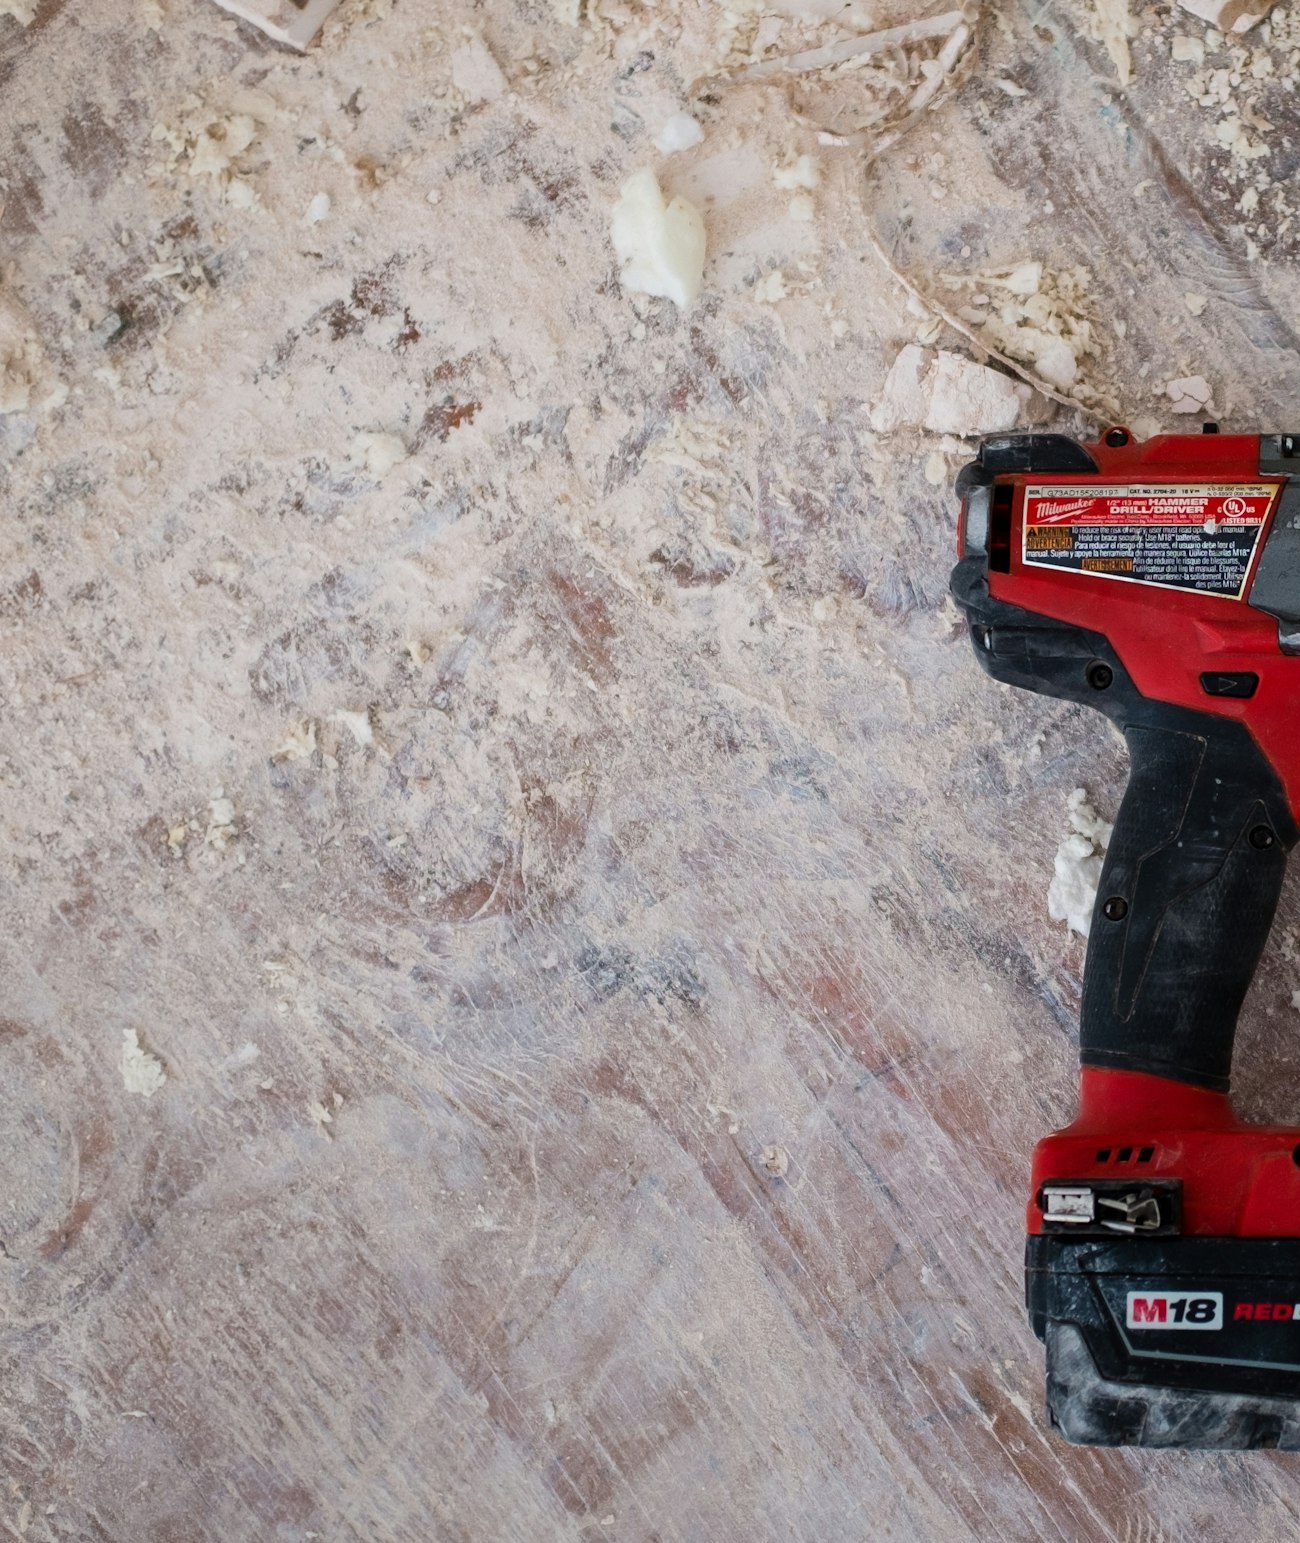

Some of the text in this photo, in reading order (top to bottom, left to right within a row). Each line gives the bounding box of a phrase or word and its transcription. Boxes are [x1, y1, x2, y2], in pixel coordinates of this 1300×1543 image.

[1035, 499, 1094, 518] Milwaukee
[1110, 506, 1204, 514] DRILL/DRIVER
[1228, 501, 1240, 513] UL
[1027, 538, 1072, 548] ADVERTENCIA
[1117, 542, 1135, 550] riesgo
[1051, 549, 1069, 558] Sujete
[1132, 1298, 1216, 1324] M18
